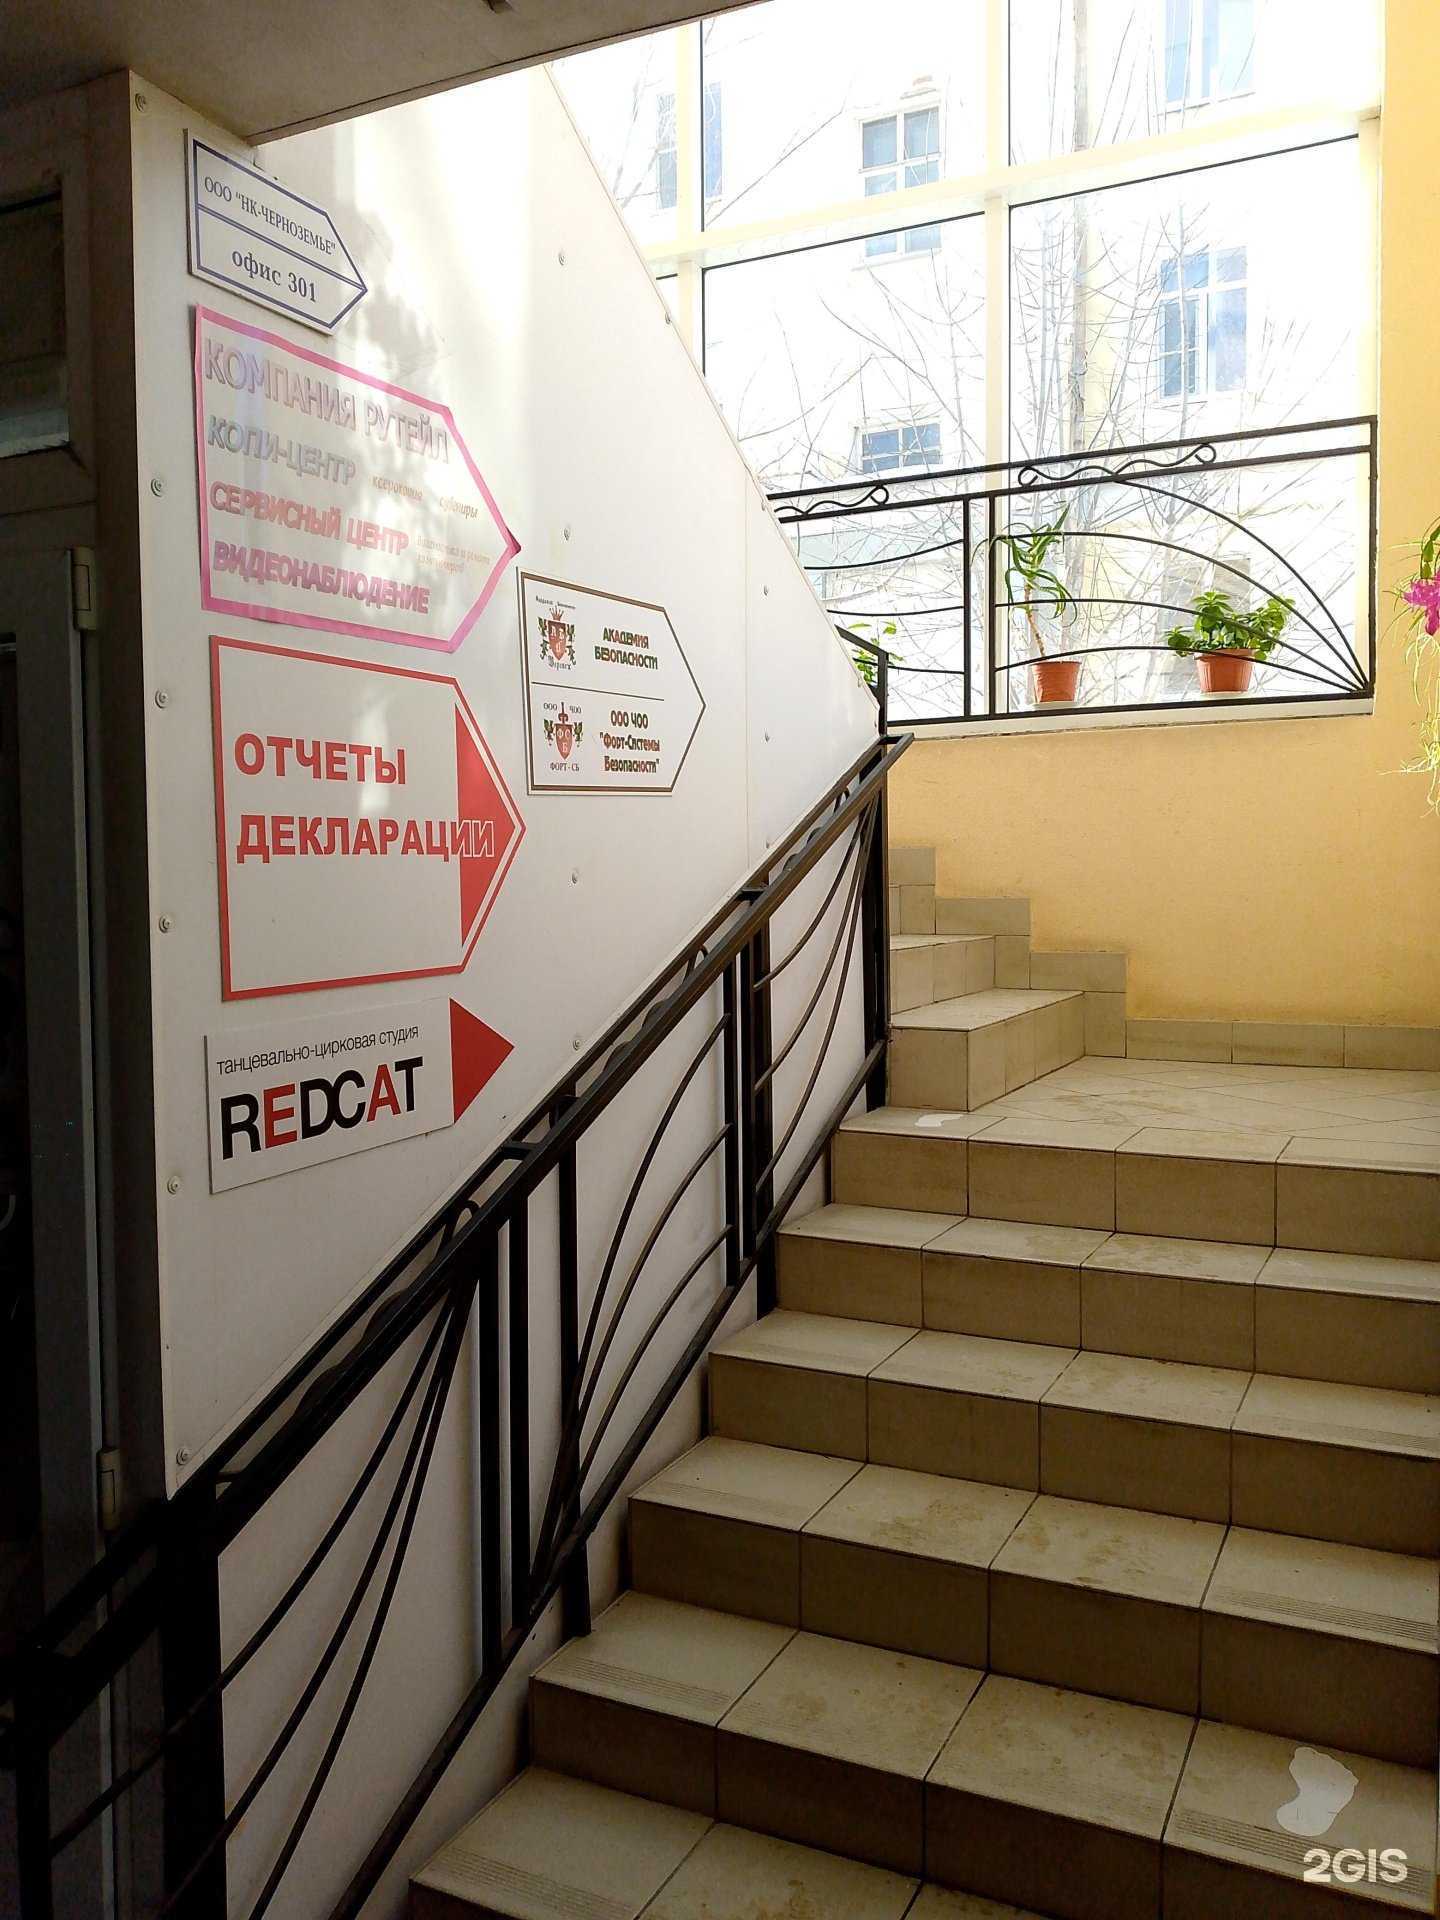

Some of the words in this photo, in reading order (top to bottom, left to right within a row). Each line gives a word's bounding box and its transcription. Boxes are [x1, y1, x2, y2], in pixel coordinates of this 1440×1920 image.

[204, 176, 232, 202] ООО
[236, 191, 336, 255] "НК-ЧЕРНОЗЕМЬЕ"
[232, 249, 281, 286] офис
[288, 271, 317, 302] 301
[205, 338, 356, 433] КОМПАНИЯ
[364, 399, 449, 464] РУТЕЙЛ
[208, 414, 357, 486] КОПИ-ЦЕНТР
[209, 480, 342, 540] СЕРВИСНЫЙ
[345, 516, 409, 556] ЦЕНТР
[213, 540, 431, 615] ВИДЕОНАБЛЮДЕНИЕ
[594, 645, 658, 670] БЕЗОПАСНОСТИ
[603, 627, 649, 649] АКАДЕМИЯ
[610, 710, 629, 727] ООО
[631, 712, 649, 729] ЧОО
[235, 733, 406, 785] ОТЧЕТЫ
[236, 814, 495, 864] ДЕКЛАРАЦИИ
[216, 1034, 376, 1075] танцевально-цирковая
[379, 1026, 419, 1049] студия
[220, 1056, 423, 1160] REDCAT
